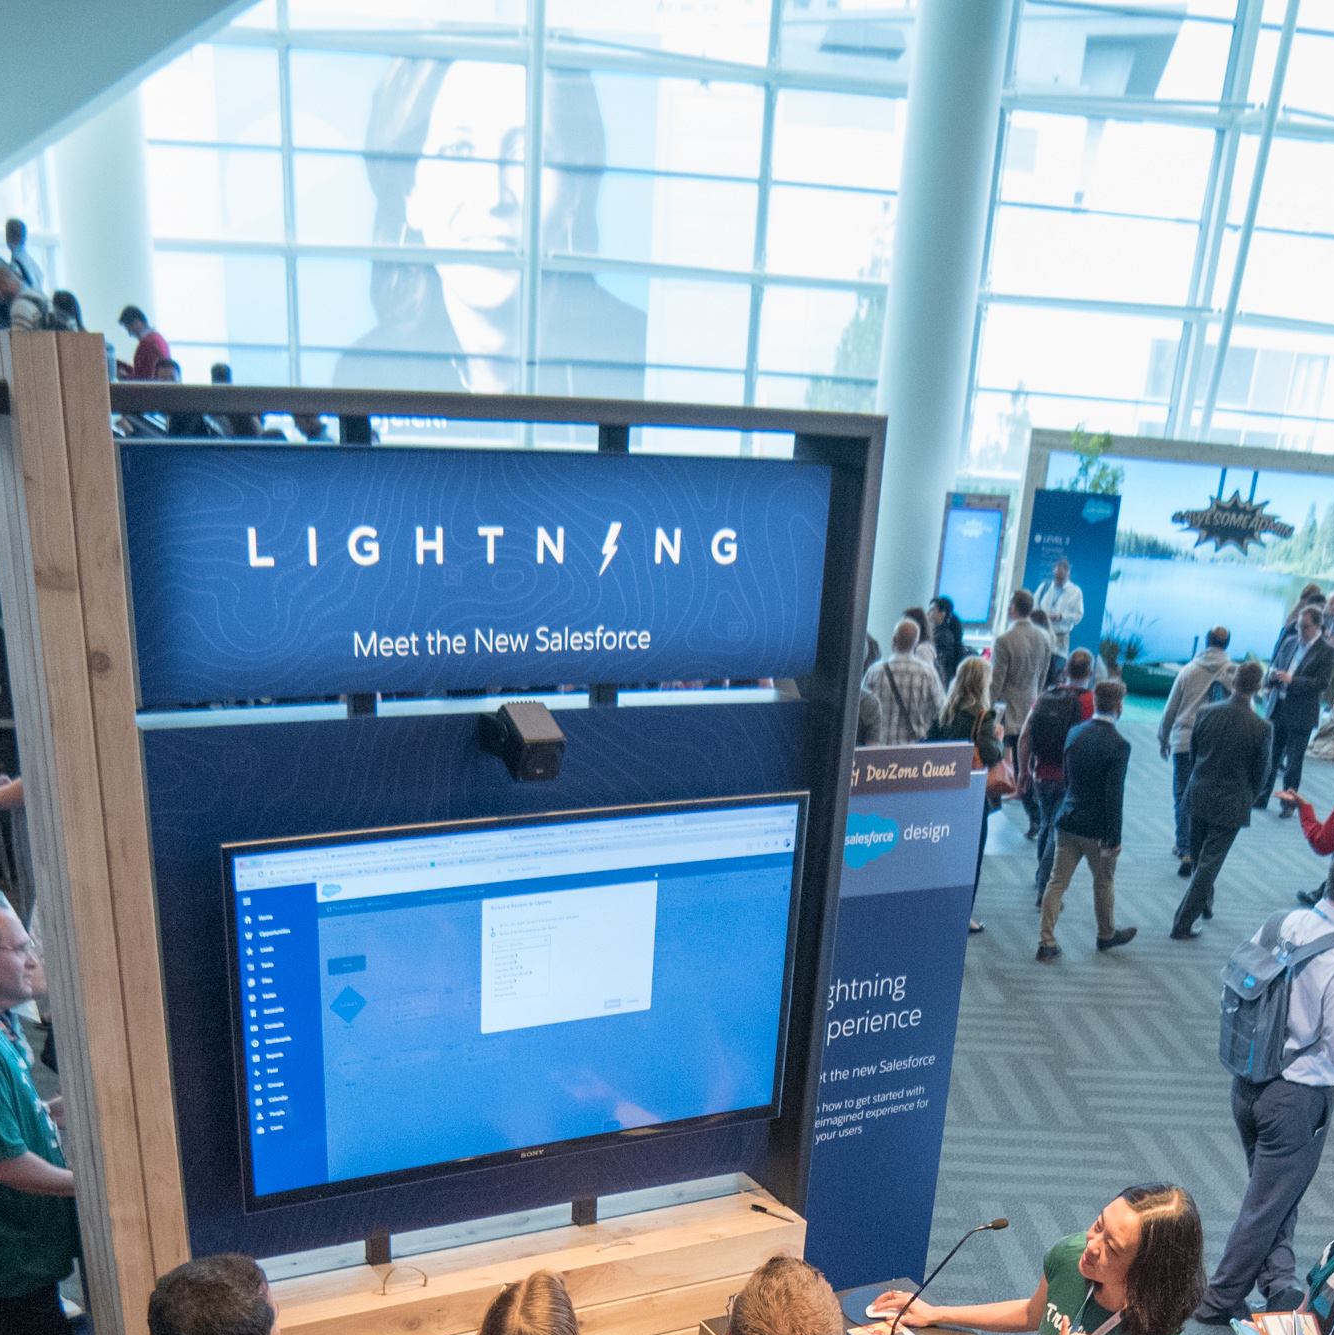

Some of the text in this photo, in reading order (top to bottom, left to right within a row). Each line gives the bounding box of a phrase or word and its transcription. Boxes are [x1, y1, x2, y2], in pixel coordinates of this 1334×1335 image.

[353, 625, 651, 658] Meet the New Salesforce
[865, 761, 957, 782] DevZone Quest
[845, 822, 950, 847] salesforce design
[827, 973, 907, 1011] ghtning
[826, 1008, 922, 1047] perience
[830, 1069, 850, 1082] the
[852, 1065, 877, 1078] new
[879, 1055, 936, 1074] Salesforce
[822, 1102, 843, 1113] how
[844, 1100, 855, 1109] to
[855, 1096, 871, 1110] get
[872, 1088, 904, 1103] started
[906, 1086, 925, 1098] with
[814, 1110, 864, 1129] eimagined
[865, 1102, 915, 1120] experience
[916, 1098, 929, 1110] for
[815, 1125, 863, 1145] your users
[520, 1149, 544, 1159] SONY
